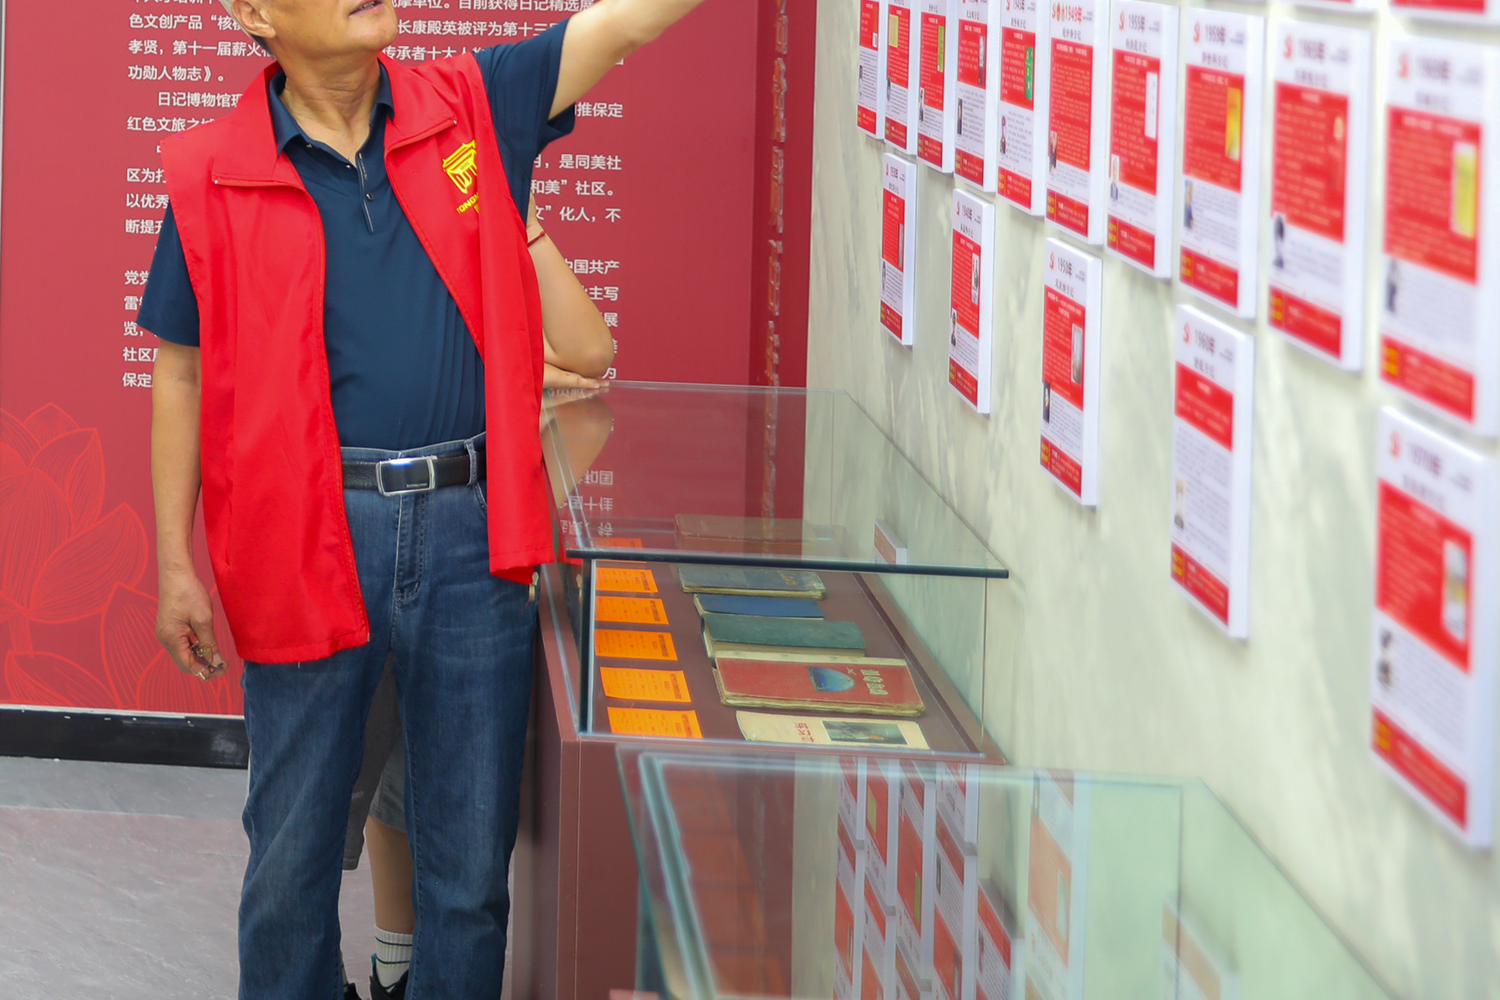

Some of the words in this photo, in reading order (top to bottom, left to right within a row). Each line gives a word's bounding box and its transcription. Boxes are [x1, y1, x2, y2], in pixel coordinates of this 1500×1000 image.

[1065, 5, 1082, 25] 1949年
[1128, 13, 1146, 34] 1955年
[128, 65, 225, 82] 功勋人物志》。
[127, 116, 215, 132] 红色文旅之
[126, 193, 169, 209] 以优秀
[124, 296, 143, 311] 雷
